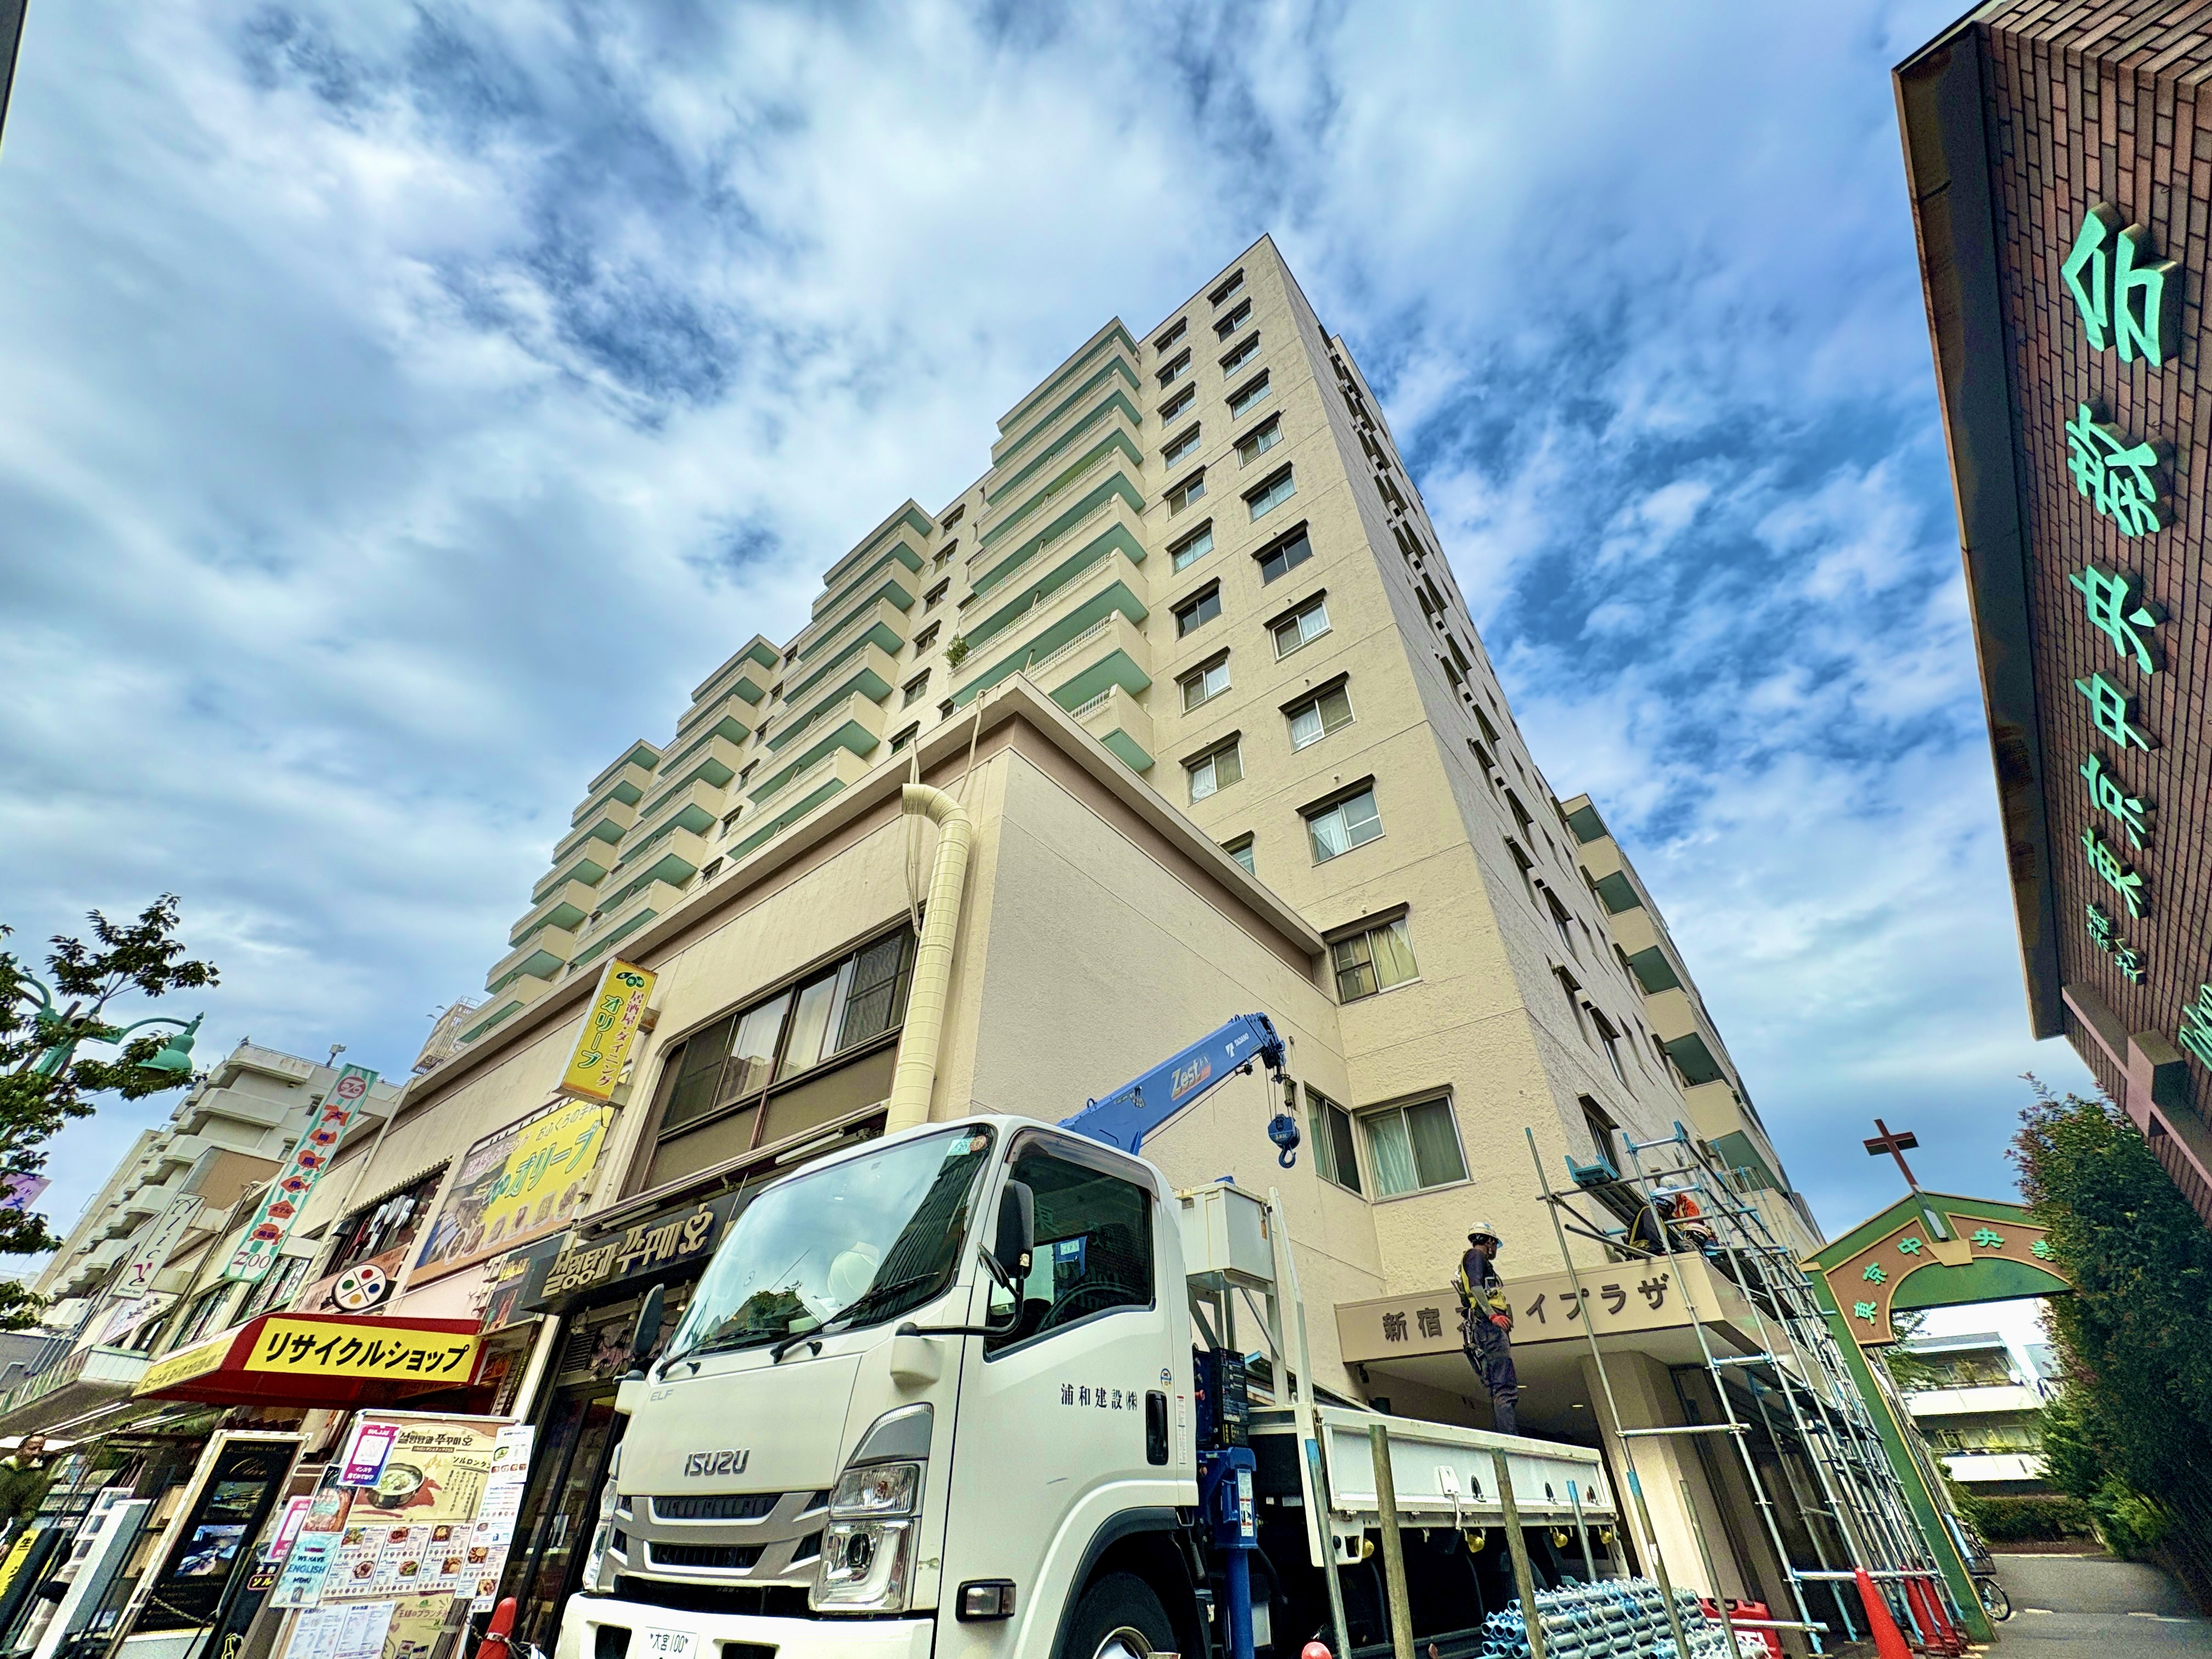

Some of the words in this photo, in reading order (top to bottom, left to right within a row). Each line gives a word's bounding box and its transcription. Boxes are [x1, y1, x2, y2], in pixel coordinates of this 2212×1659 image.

[578, 995, 624, 1069] オリーブ
[1234, 1032, 1249, 1047] TADANO
[1171, 1059, 1201, 1098] Zest
[505, 1120, 601, 1199] オリーブ
[232, 1251, 272, 1269] ZOO
[1383, 1272, 1670, 1342] 新宿イプラザ
[266, 1332, 470, 1374] リサイクルショップ
[650, 1388, 675, 1402] ELF
[684, 1447, 751, 1477] ISUZU
[286, 1564, 326, 1574] ENGLISH
[652, 1632, 670, 1651] 大宮
[669, 1634, 685, 1654] 100
